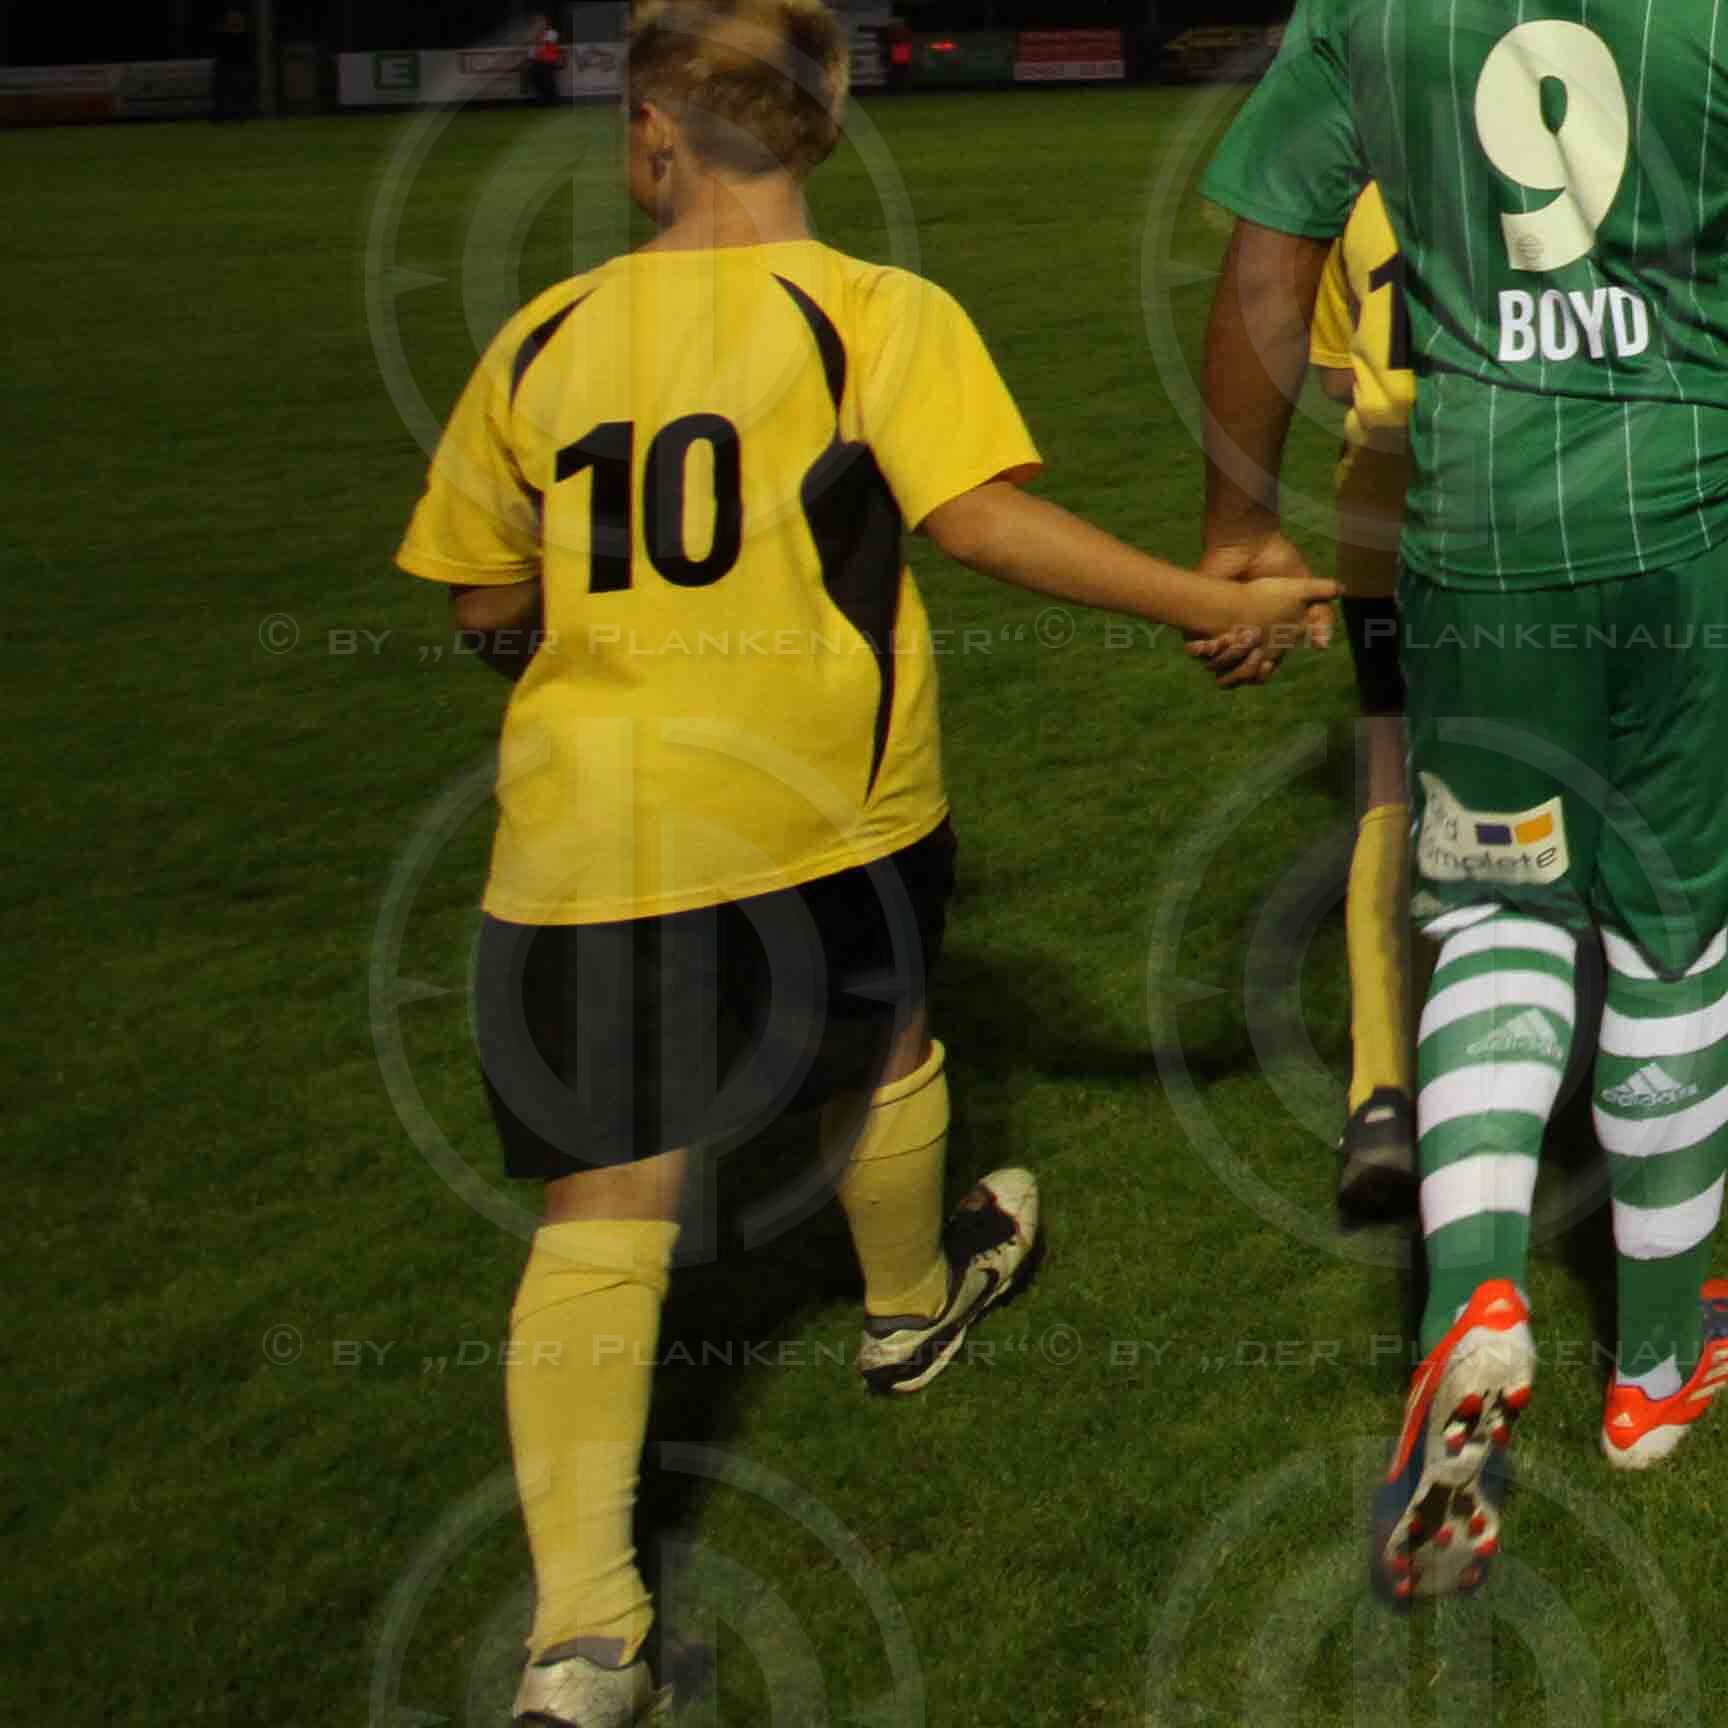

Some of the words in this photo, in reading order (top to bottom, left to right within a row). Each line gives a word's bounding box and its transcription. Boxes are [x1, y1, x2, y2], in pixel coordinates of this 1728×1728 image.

[1475, 19, 1629, 271] 9
[1498, 286, 1649, 362] BOYD
[555, 412, 743, 594] 10
